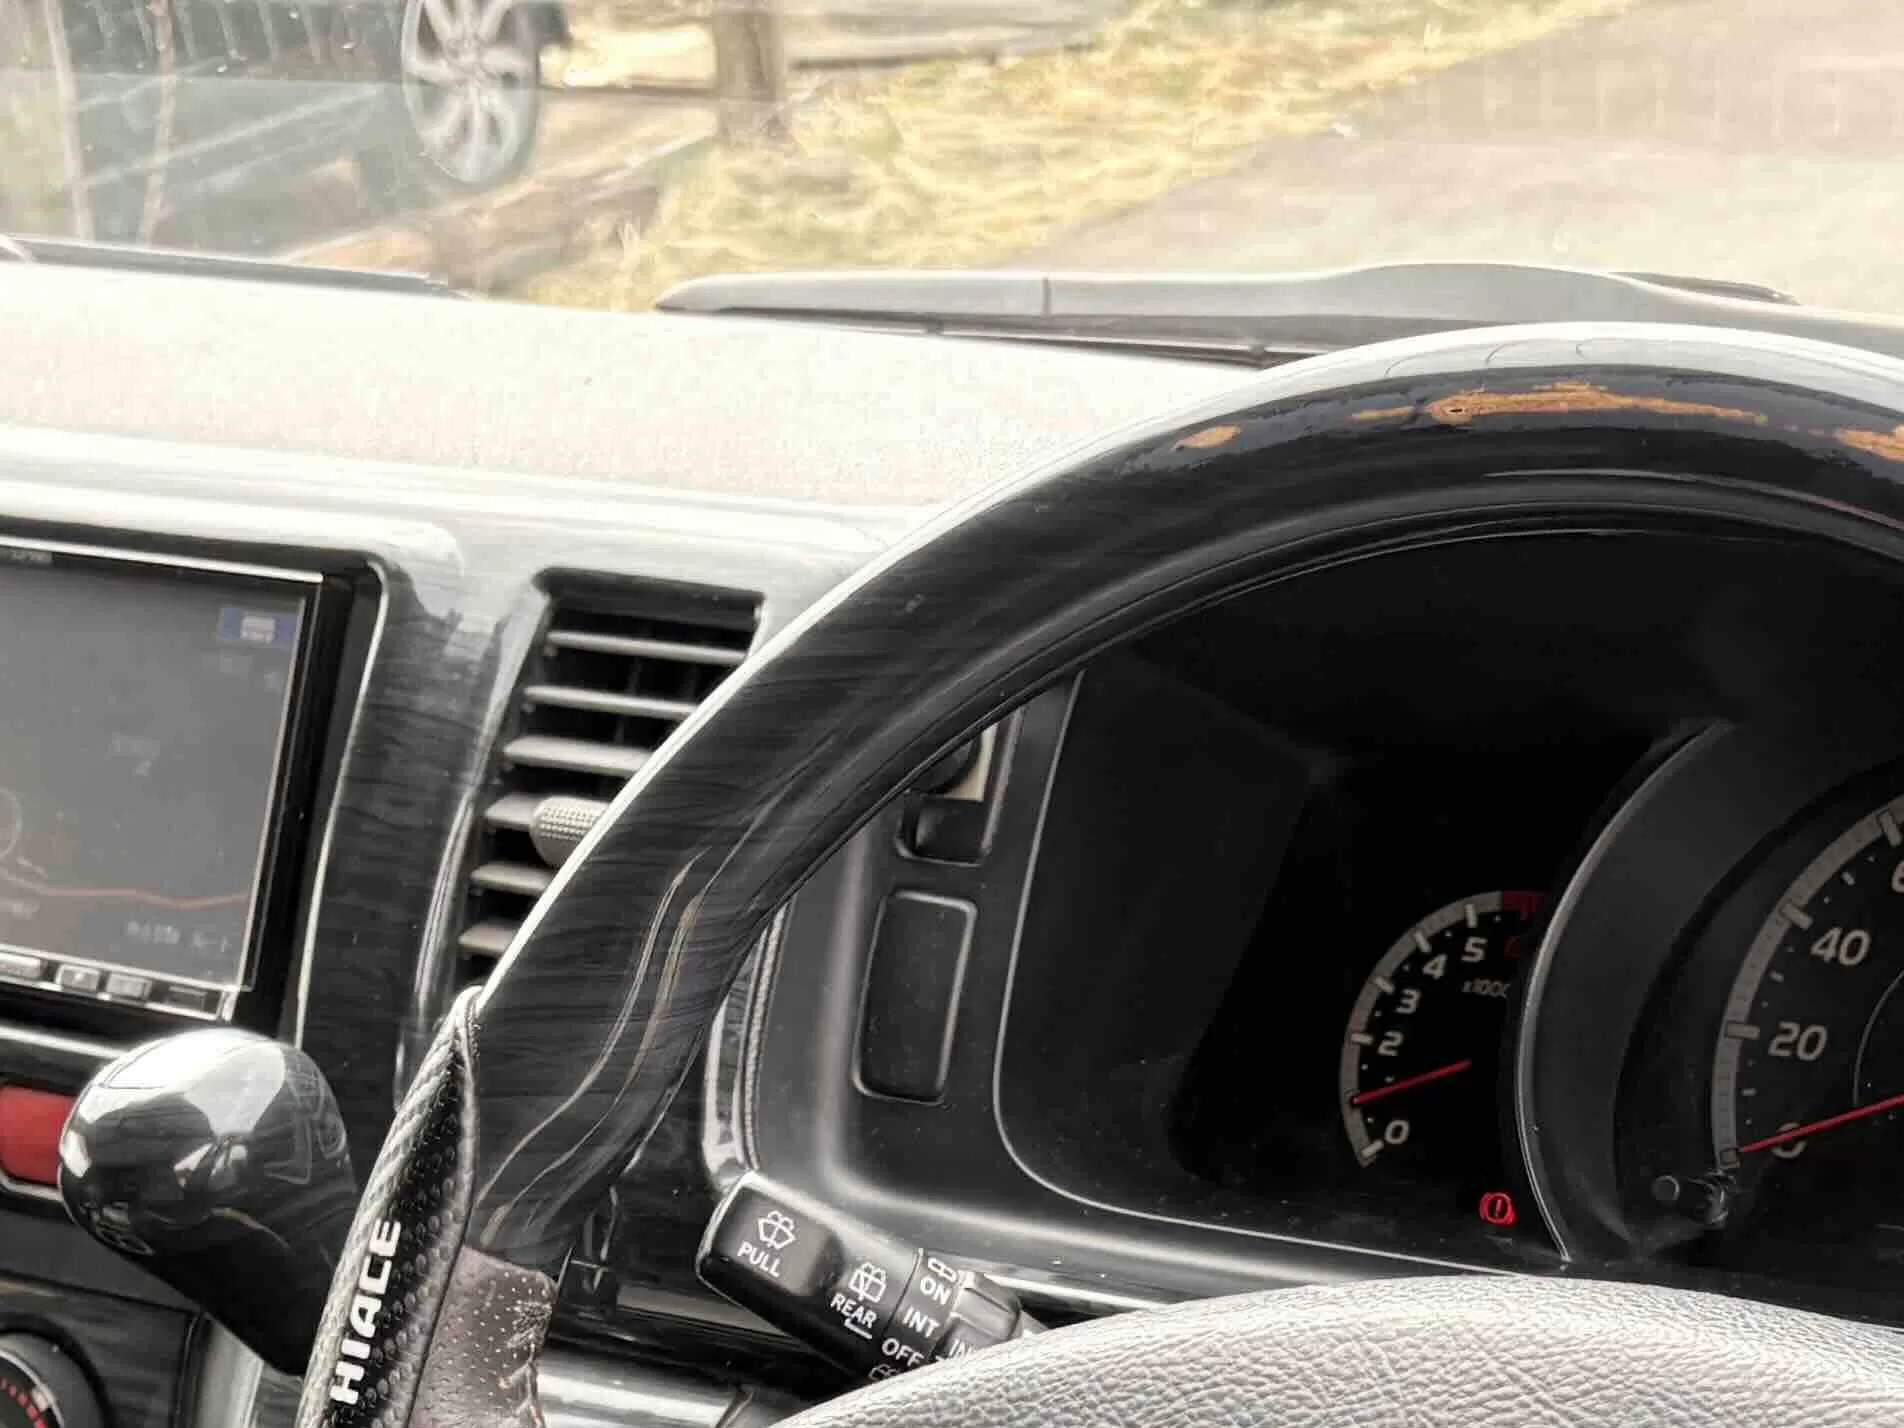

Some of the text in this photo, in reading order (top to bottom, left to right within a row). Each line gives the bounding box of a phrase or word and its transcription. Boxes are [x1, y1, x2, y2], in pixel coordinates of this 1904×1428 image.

[1461, 936, 1487, 962] 5
[1811, 929, 1871, 966] 40
[1422, 953, 1447, 979] 4
[1395, 988, 1420, 1014] 3
[1377, 1031, 1403, 1056] 2
[1769, 1022, 1828, 1061] 20
[1384, 1120, 1409, 1144] 0
[737, 1241, 780, 1278] PULL
[920, 1277, 951, 1305] ON
[329, 1217, 402, 1405] HIACE
[830, 1294, 877, 1330] REAR
[902, 1306, 940, 1340] INT
[881, 1338, 925, 1368] OFF
